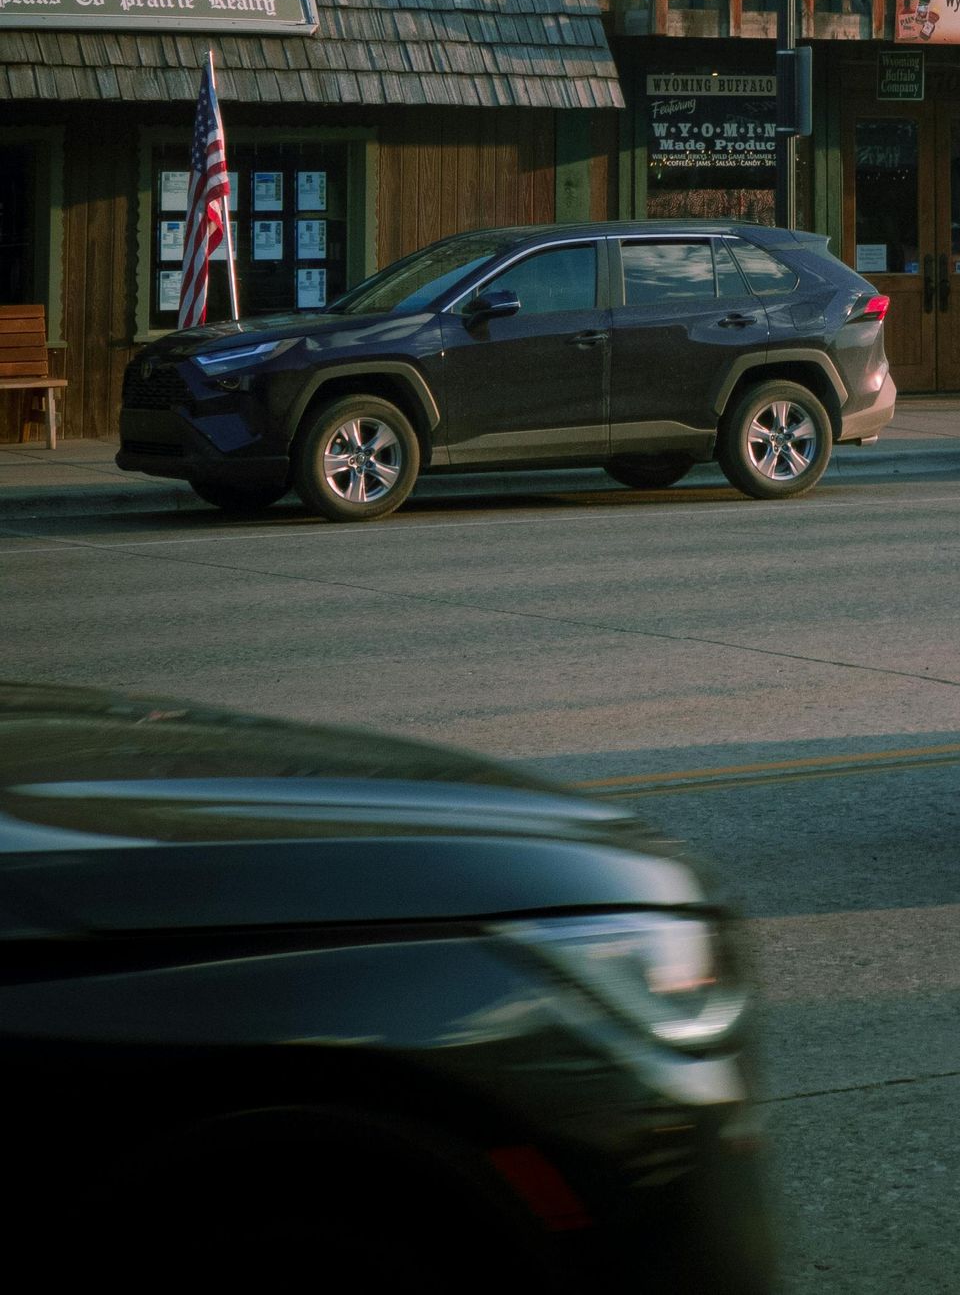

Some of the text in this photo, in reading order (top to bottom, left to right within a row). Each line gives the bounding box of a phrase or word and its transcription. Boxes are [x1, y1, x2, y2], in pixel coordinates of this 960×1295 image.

[883, 56, 919, 71] Wyoming
[886, 69, 915, 81] Buffalo
[653, 78, 773, 93] WYOMING BUFFALO
[881, 81, 919, 97] Company
[650, 99, 696, 118] Featuring
[660, 139, 776, 151] Made Produc
